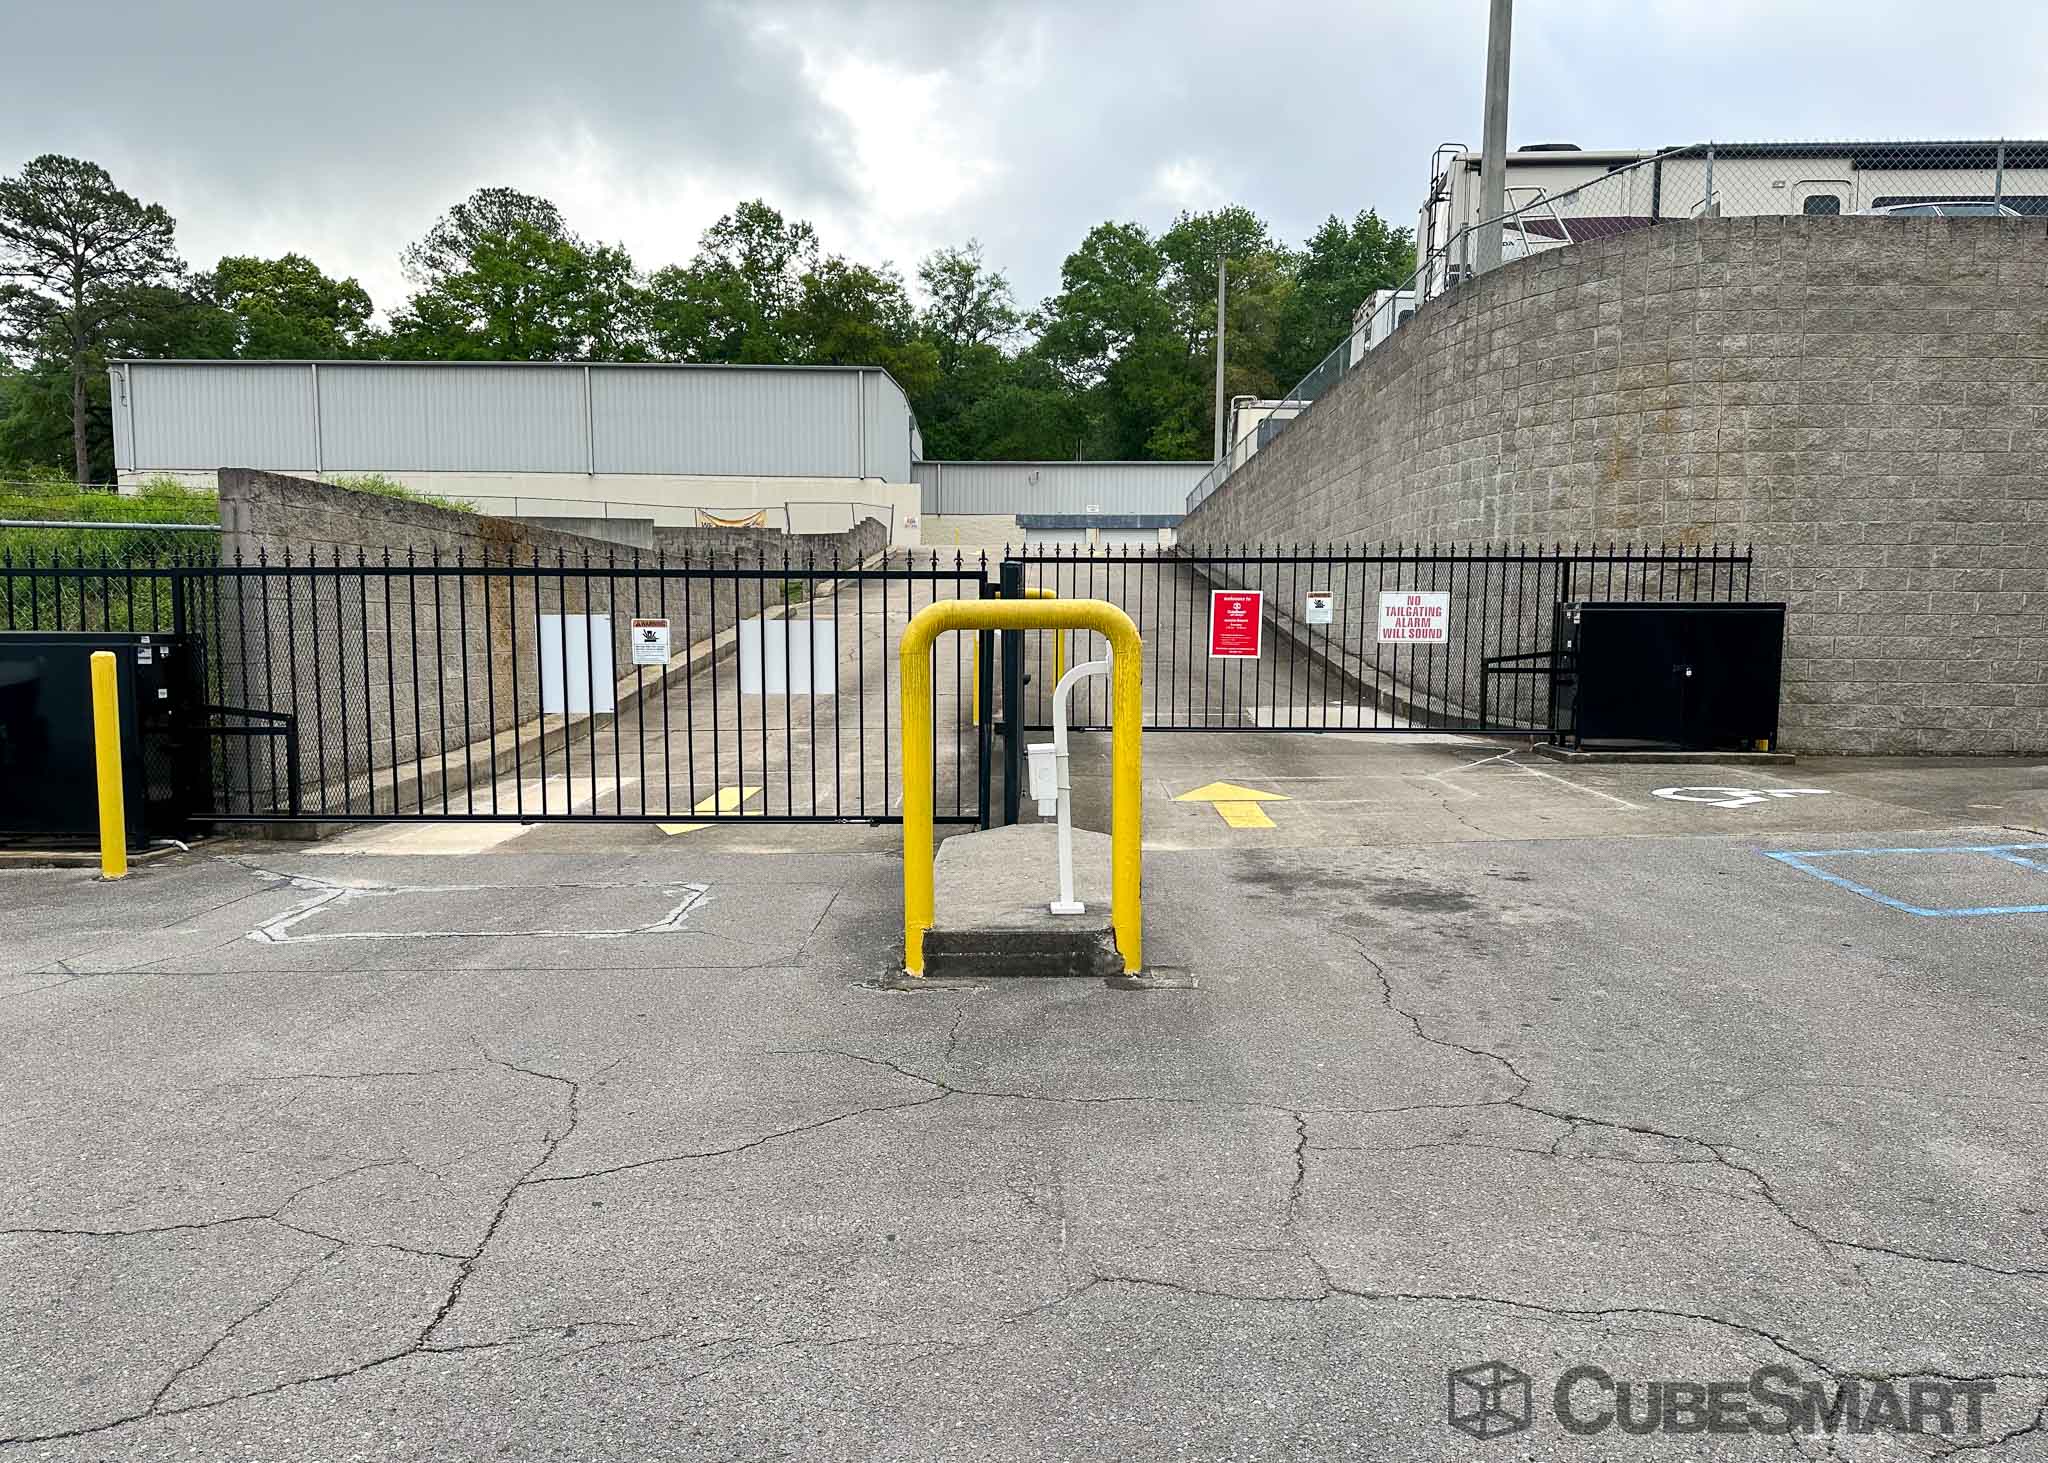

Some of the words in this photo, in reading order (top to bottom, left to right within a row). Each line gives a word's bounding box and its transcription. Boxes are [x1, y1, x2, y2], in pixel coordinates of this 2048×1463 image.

[1407, 595, 1421, 606] NO
[1385, 606, 1442, 617] TAILGATING
[1395, 617, 1431, 628] ALARM
[1383, 628, 1406, 639] WILL
[1408, 628, 1442, 639] SOUND
